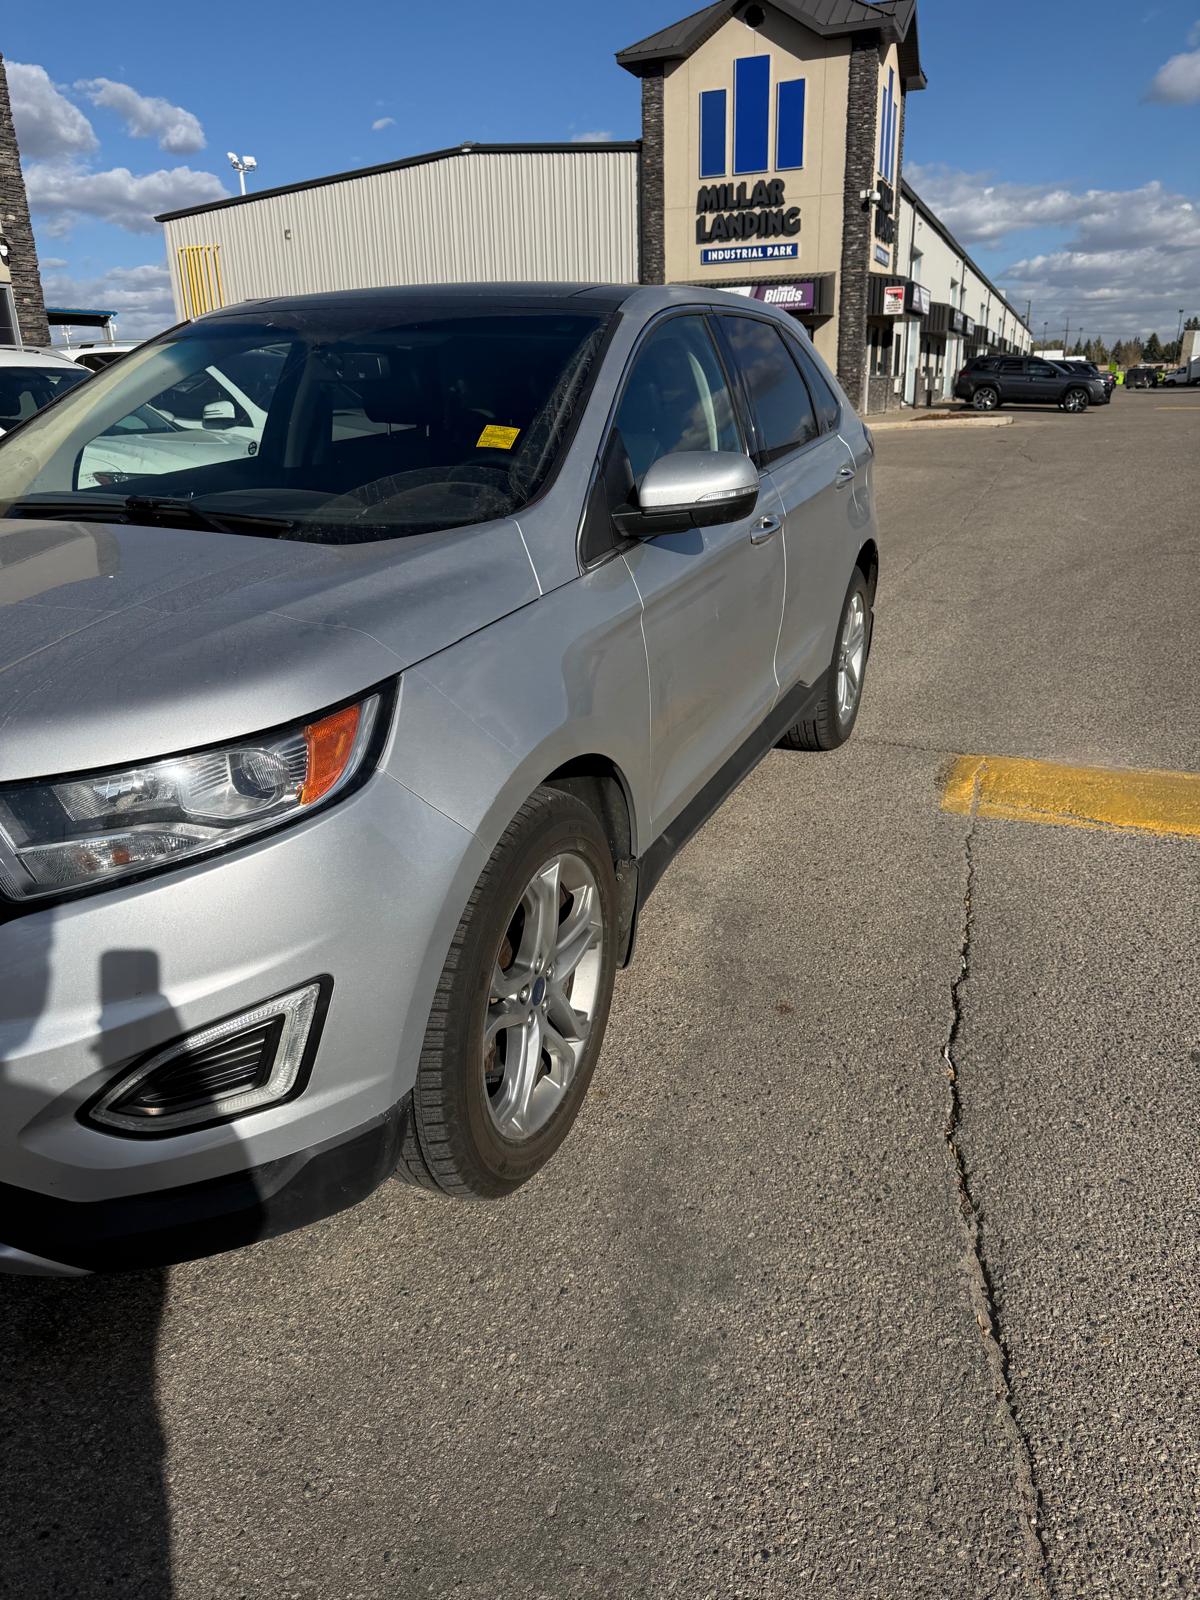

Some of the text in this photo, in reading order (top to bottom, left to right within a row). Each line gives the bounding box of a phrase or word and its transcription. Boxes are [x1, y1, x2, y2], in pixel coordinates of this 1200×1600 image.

[696, 178, 785, 214] MILLAR
[696, 207, 801, 245] LANDING
[708, 245, 793, 261] INDUSTRIAL PARK
[764, 288, 803, 303] Blinds
